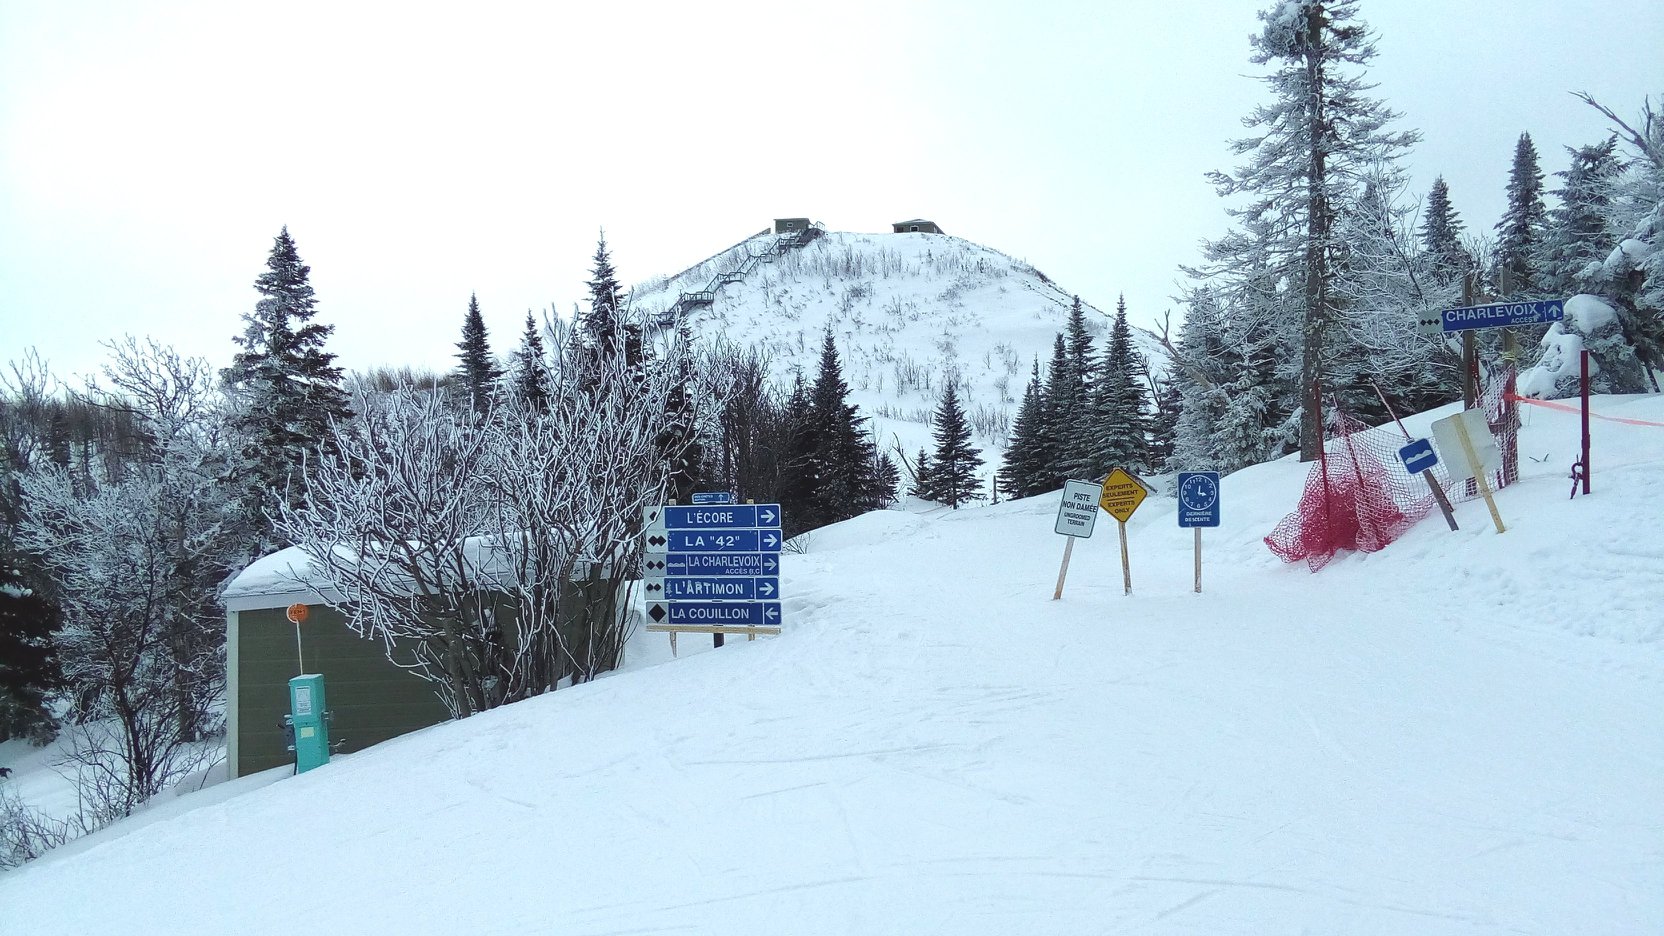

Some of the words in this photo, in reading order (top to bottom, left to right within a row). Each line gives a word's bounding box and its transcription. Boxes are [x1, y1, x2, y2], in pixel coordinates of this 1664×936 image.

[1446, 303, 1538, 322] CHARLEVOIX
[1106, 483, 1133, 491] EXPERTS
[1074, 492, 1091, 501] PISTE
[1062, 500, 1076, 509] NON
[1076, 502, 1098, 512] DAMÉE
[687, 509, 733, 524] L'ÉCORE
[685, 536, 705, 546] LA
[710, 535, 740, 547] "42"
[688, 556, 700, 567] LA
[702, 556, 760, 567] CHARLEVOIX
[671, 608, 686, 619] LA
[689, 608, 749, 619] COUILLON
